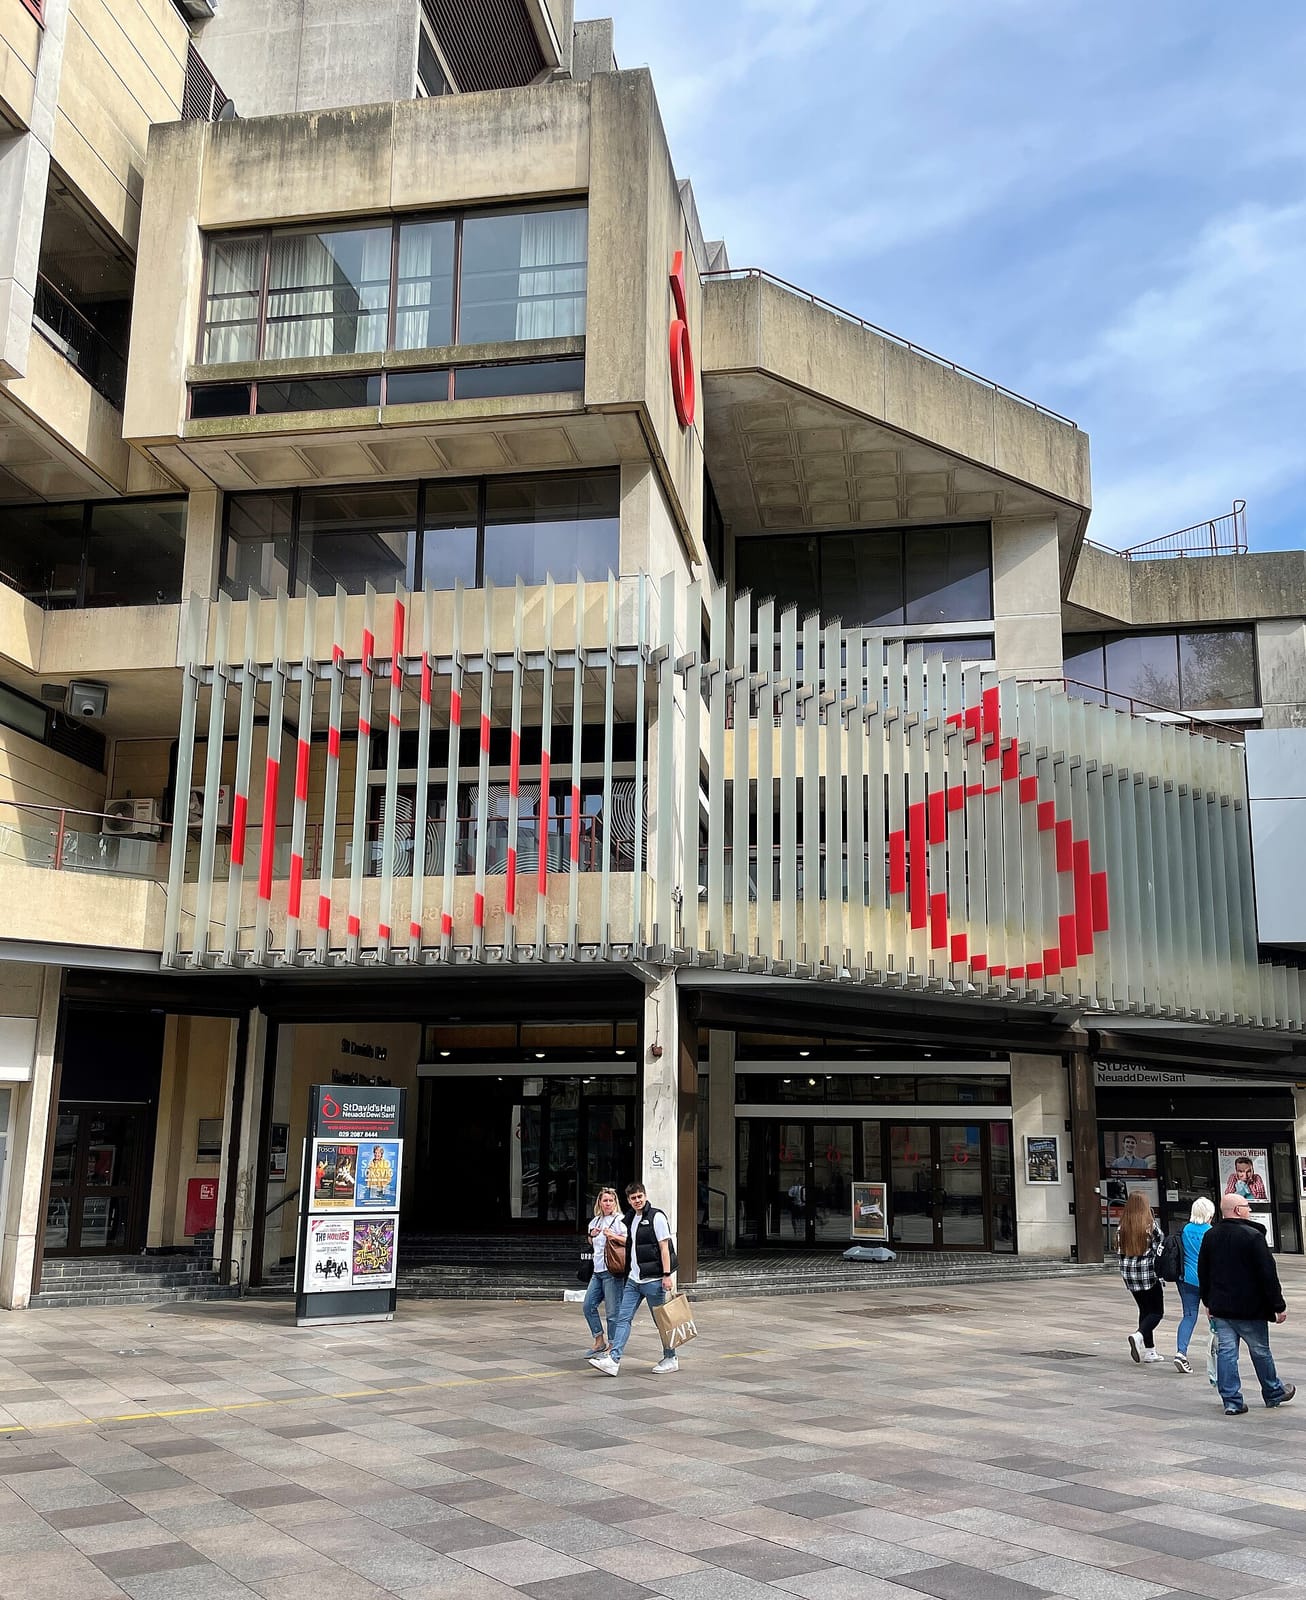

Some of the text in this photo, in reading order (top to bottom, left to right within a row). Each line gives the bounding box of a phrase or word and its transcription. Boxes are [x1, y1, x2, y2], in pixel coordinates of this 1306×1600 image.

[1098, 1073, 1186, 1082] Neuadd Dewi Sant
[381, 1104, 395, 1112] Hall
[361, 1160, 395, 1169] SANDI
[360, 1169, 394, 1178] TOKSVIG
[315, 1232, 326, 1242] THE
